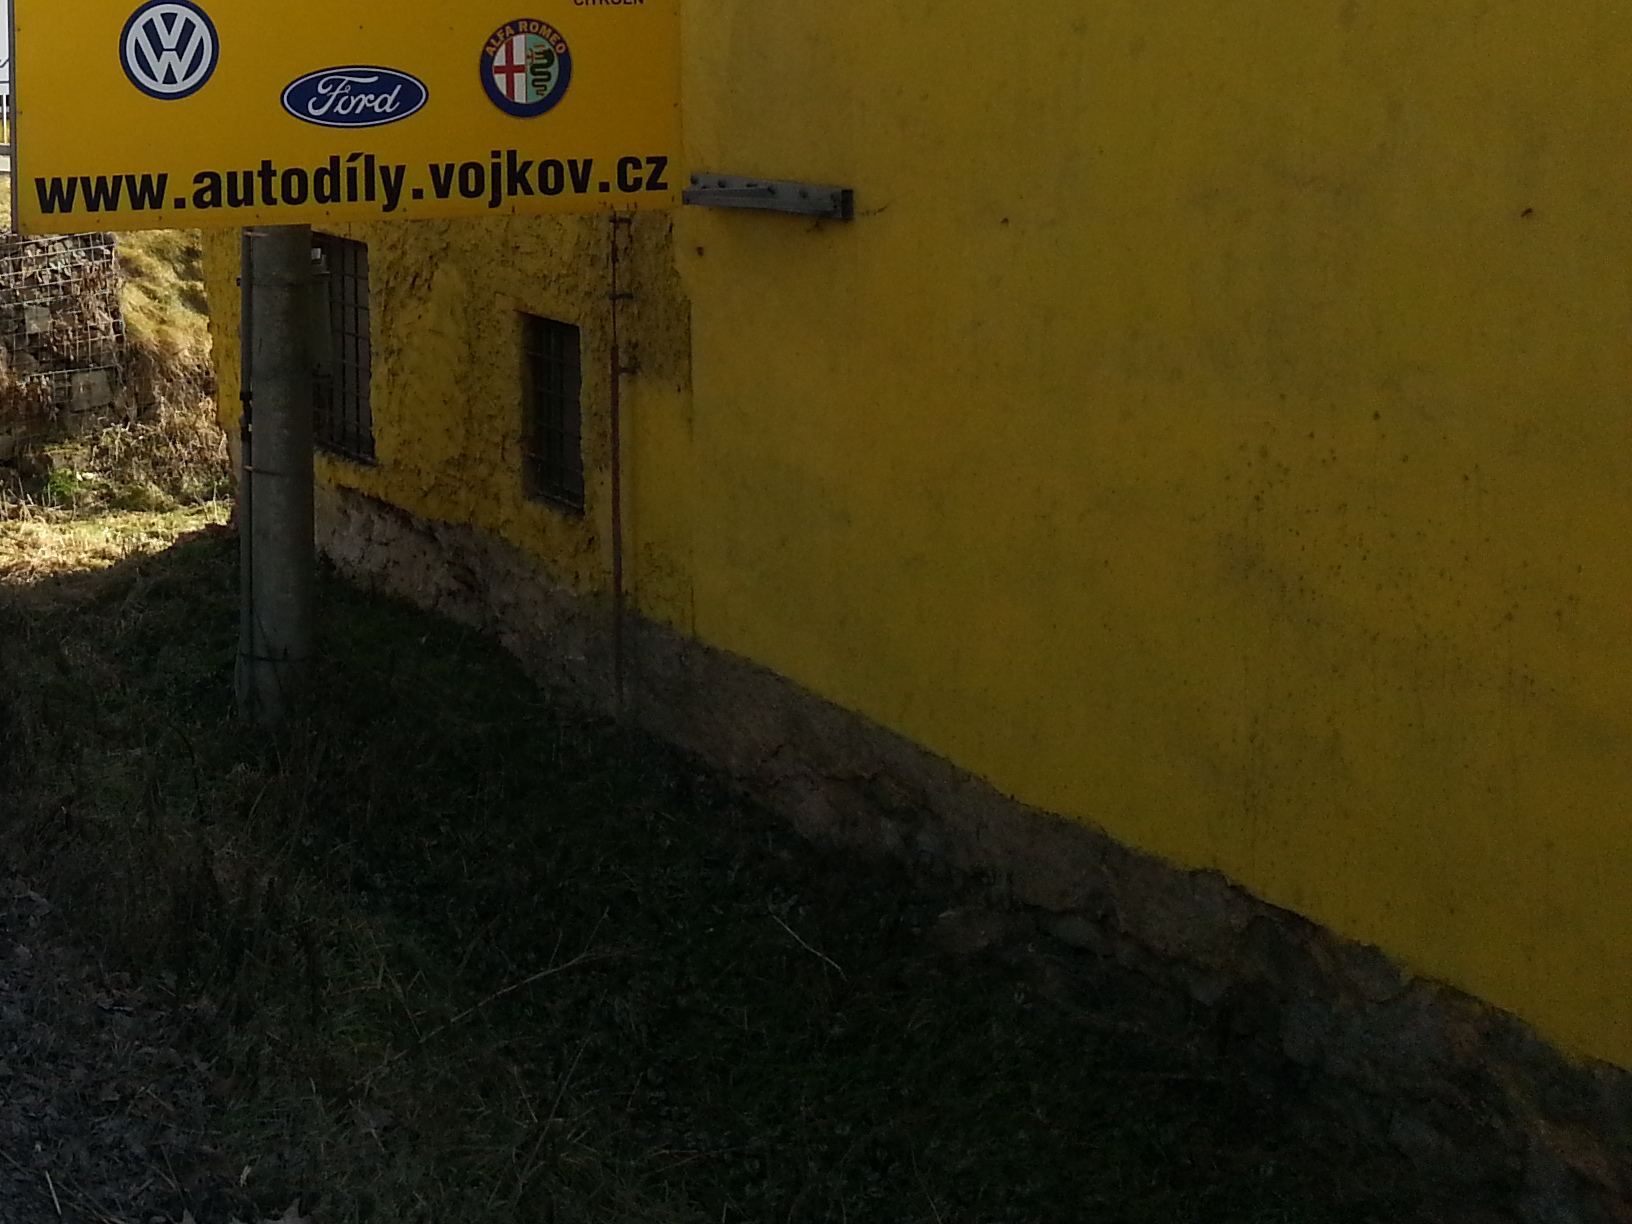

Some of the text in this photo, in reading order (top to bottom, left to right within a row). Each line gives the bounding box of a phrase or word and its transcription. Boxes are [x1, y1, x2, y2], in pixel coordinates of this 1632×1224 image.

[485, 20, 567, 57] ALFA ROMEO
[307, 75, 402, 116] Ford
[34, 149, 669, 214] www.autodíly.vojkov.cz
